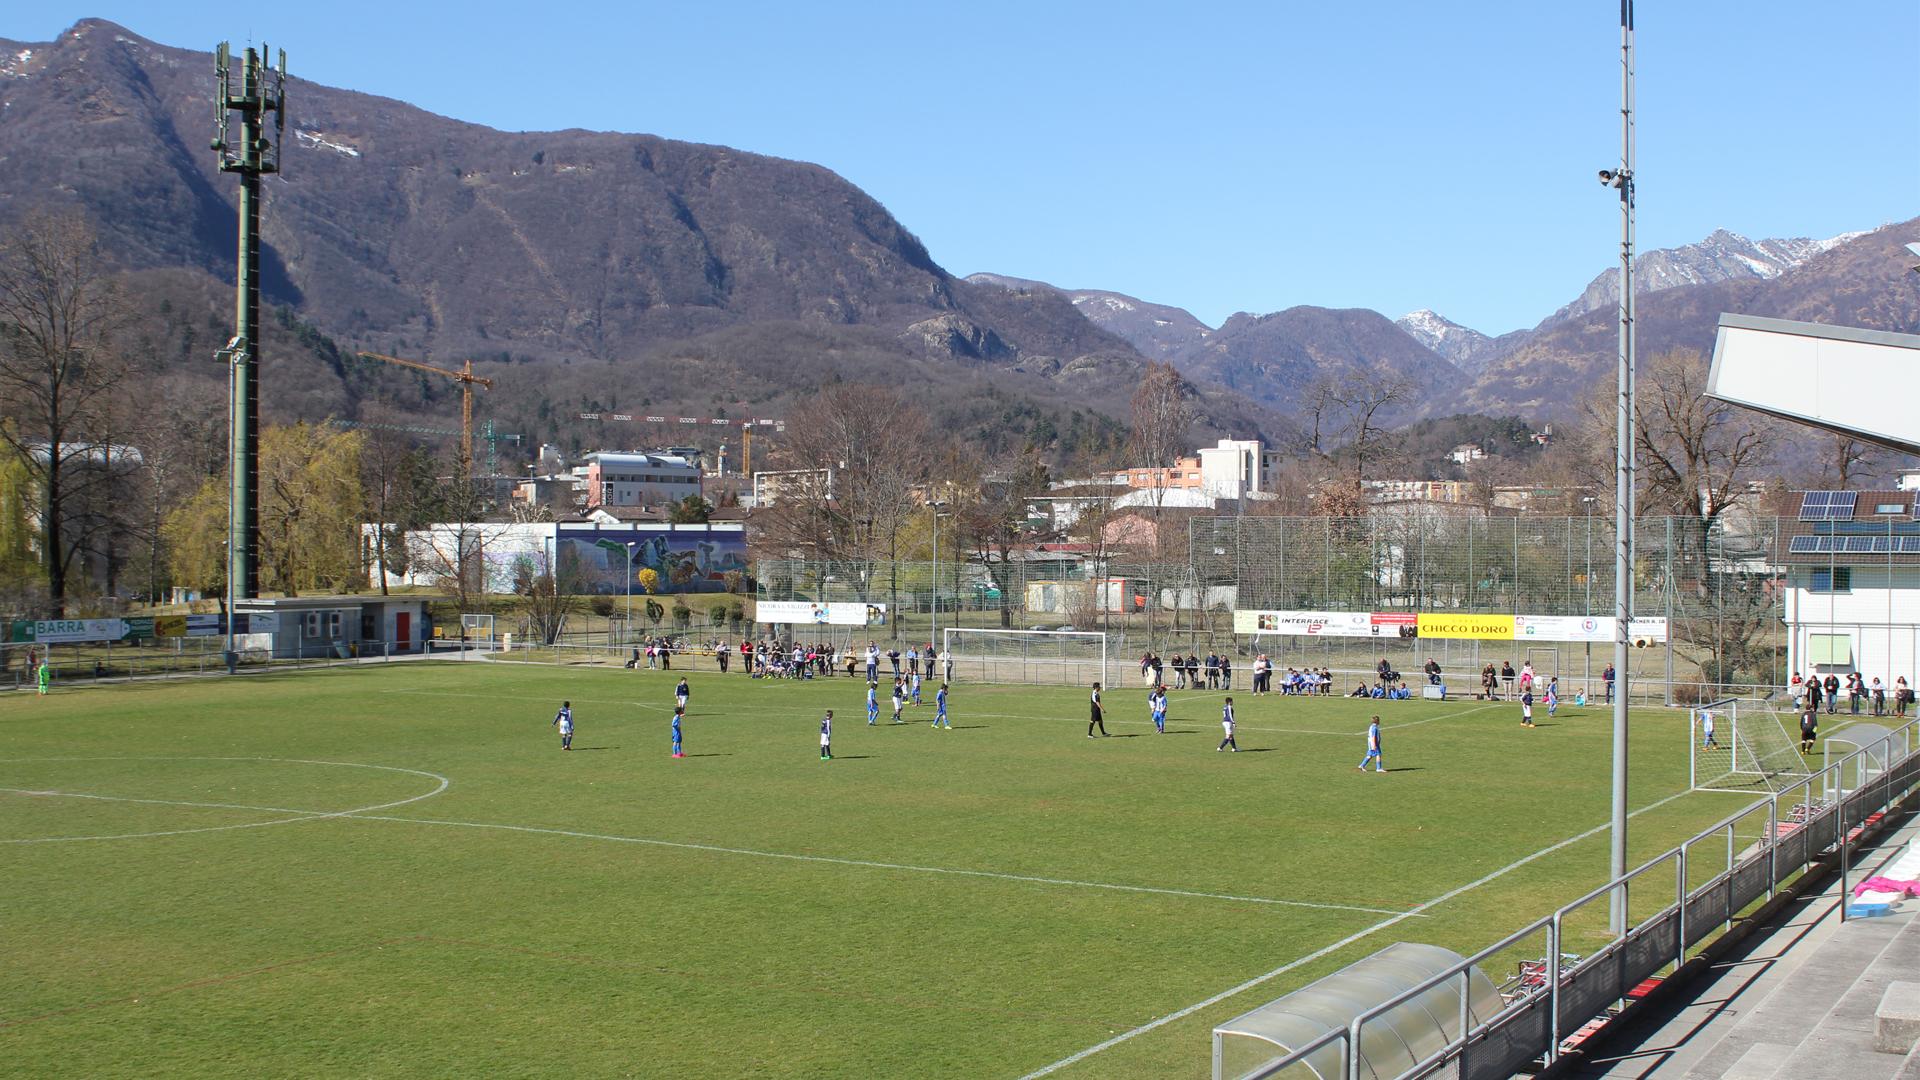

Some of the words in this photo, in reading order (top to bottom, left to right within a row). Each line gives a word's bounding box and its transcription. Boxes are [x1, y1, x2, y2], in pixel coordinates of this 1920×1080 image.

[37, 621, 86, 634] BARRA
[1422, 624, 1468, 633] CHICCO
[1471, 625, 1508, 634] DORO
[1804, 714, 1808, 723] 1
